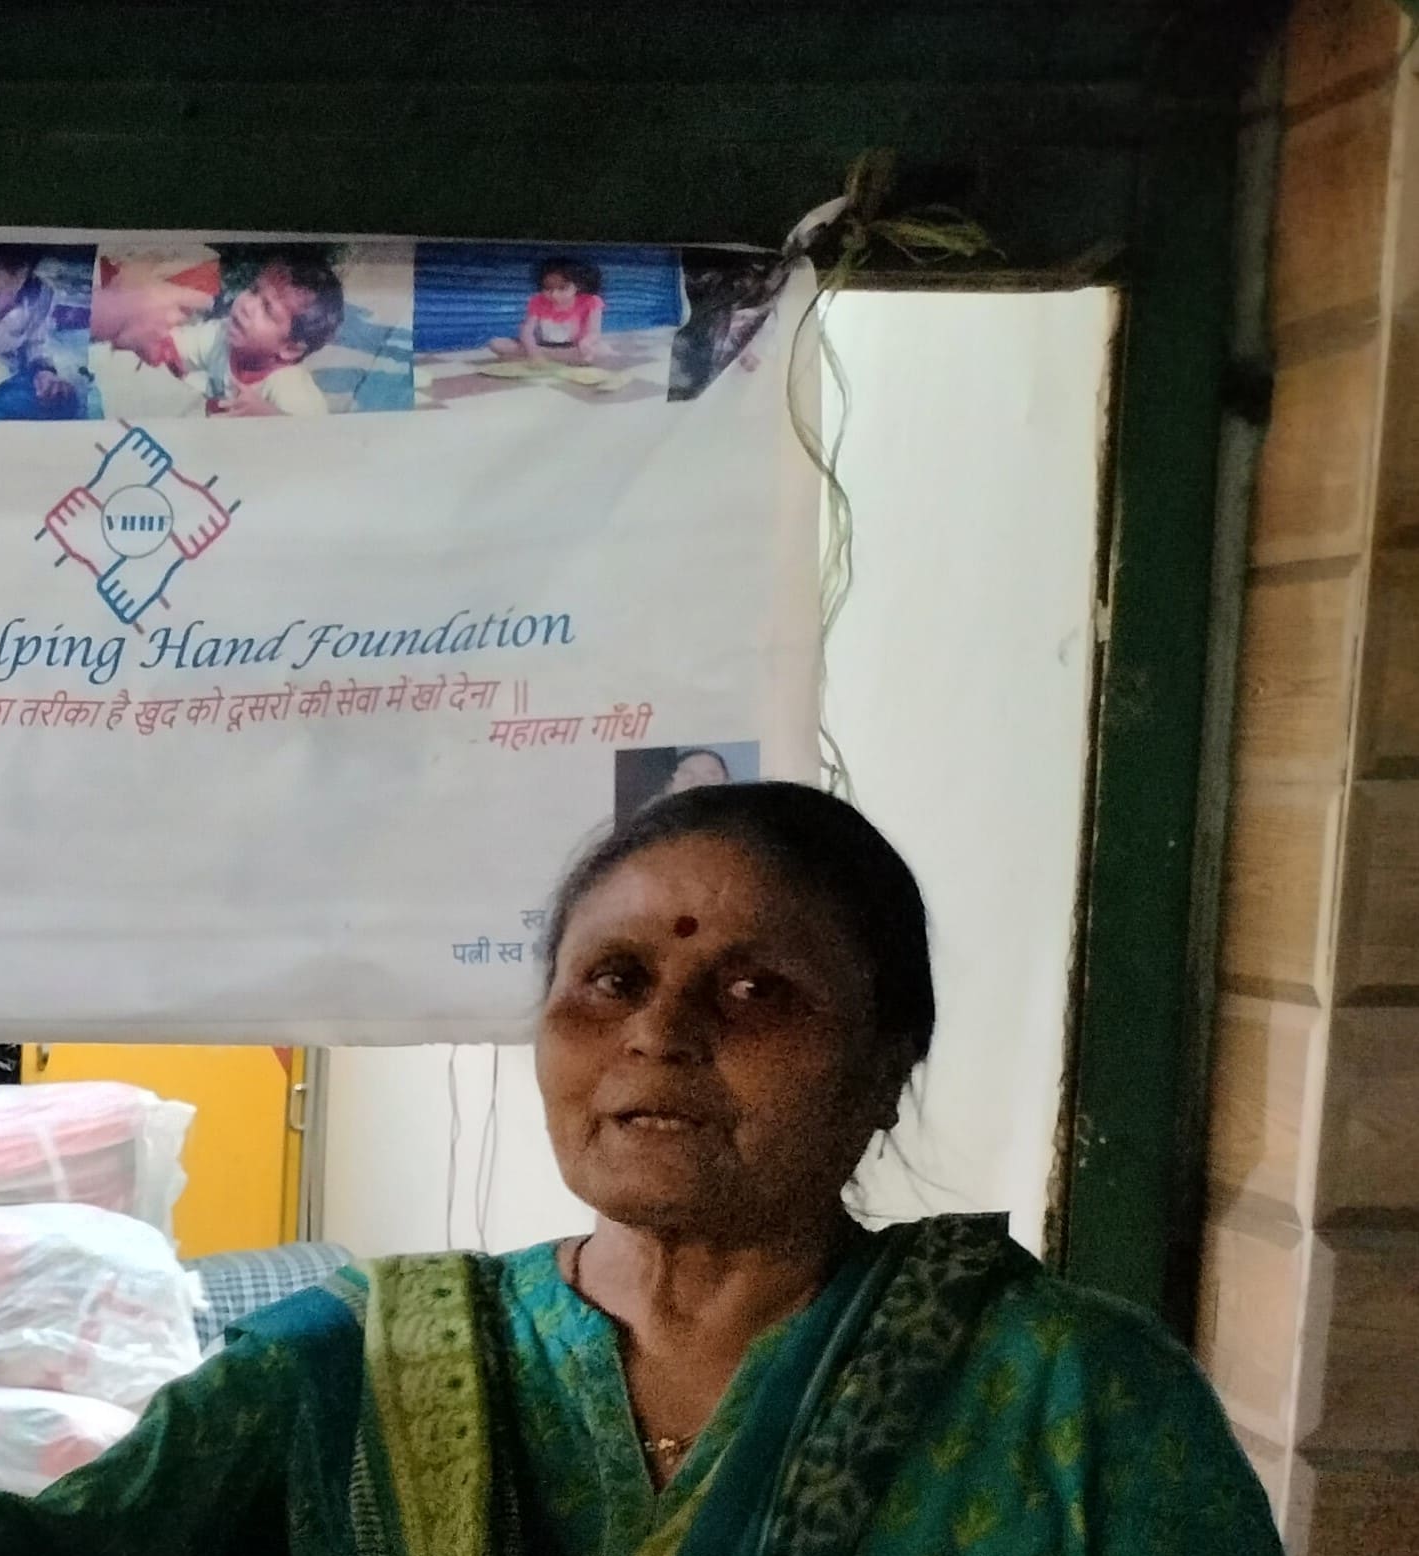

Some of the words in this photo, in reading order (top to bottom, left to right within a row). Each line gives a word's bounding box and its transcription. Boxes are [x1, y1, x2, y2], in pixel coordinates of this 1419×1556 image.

[139, 619, 305, 670] Hand
[290, 608, 577, 670] Foundation
[19, 690, 102, 730] तरीका
[106, 689, 132, 731] है
[135, 699, 184, 736] खुद
[186, 686, 224, 726] को
[226, 681, 298, 732] दूसरों
[298, 679, 333, 718] की
[337, 677, 382, 716] सेवा
[385, 674, 414, 712] में
[411, 673, 447, 712] खो
[449, 671, 502, 711] देना
[488, 716, 584, 751] महात्मा
[497, 942, 524, 964] स्व
